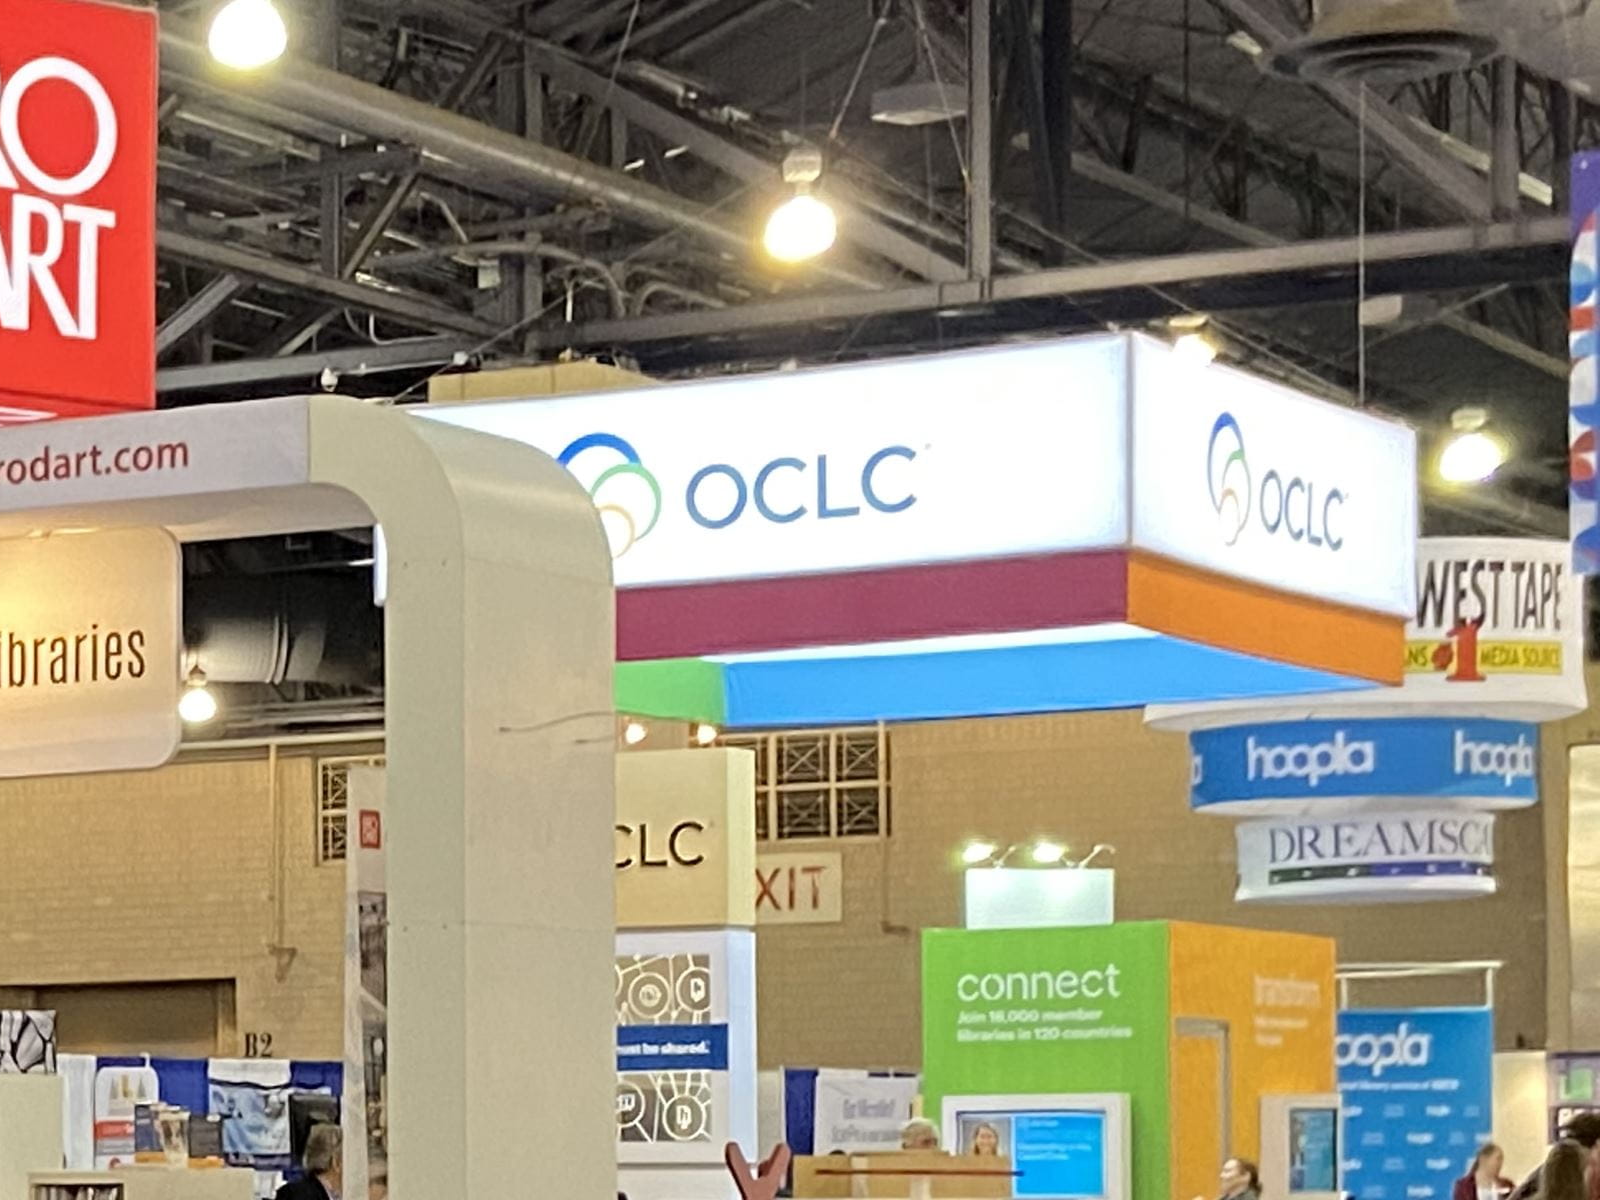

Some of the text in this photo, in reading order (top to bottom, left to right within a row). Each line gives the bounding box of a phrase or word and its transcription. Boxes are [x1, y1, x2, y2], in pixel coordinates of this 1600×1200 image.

[686, 444, 917, 529] OCLC
[1260, 469, 1345, 552] OCLC
[1511, 561, 1563, 630] TAPE
[1247, 730, 1374, 787] hoopla
[957, 963, 1121, 1001] connect
[244, 1032, 273, 1058] B2
